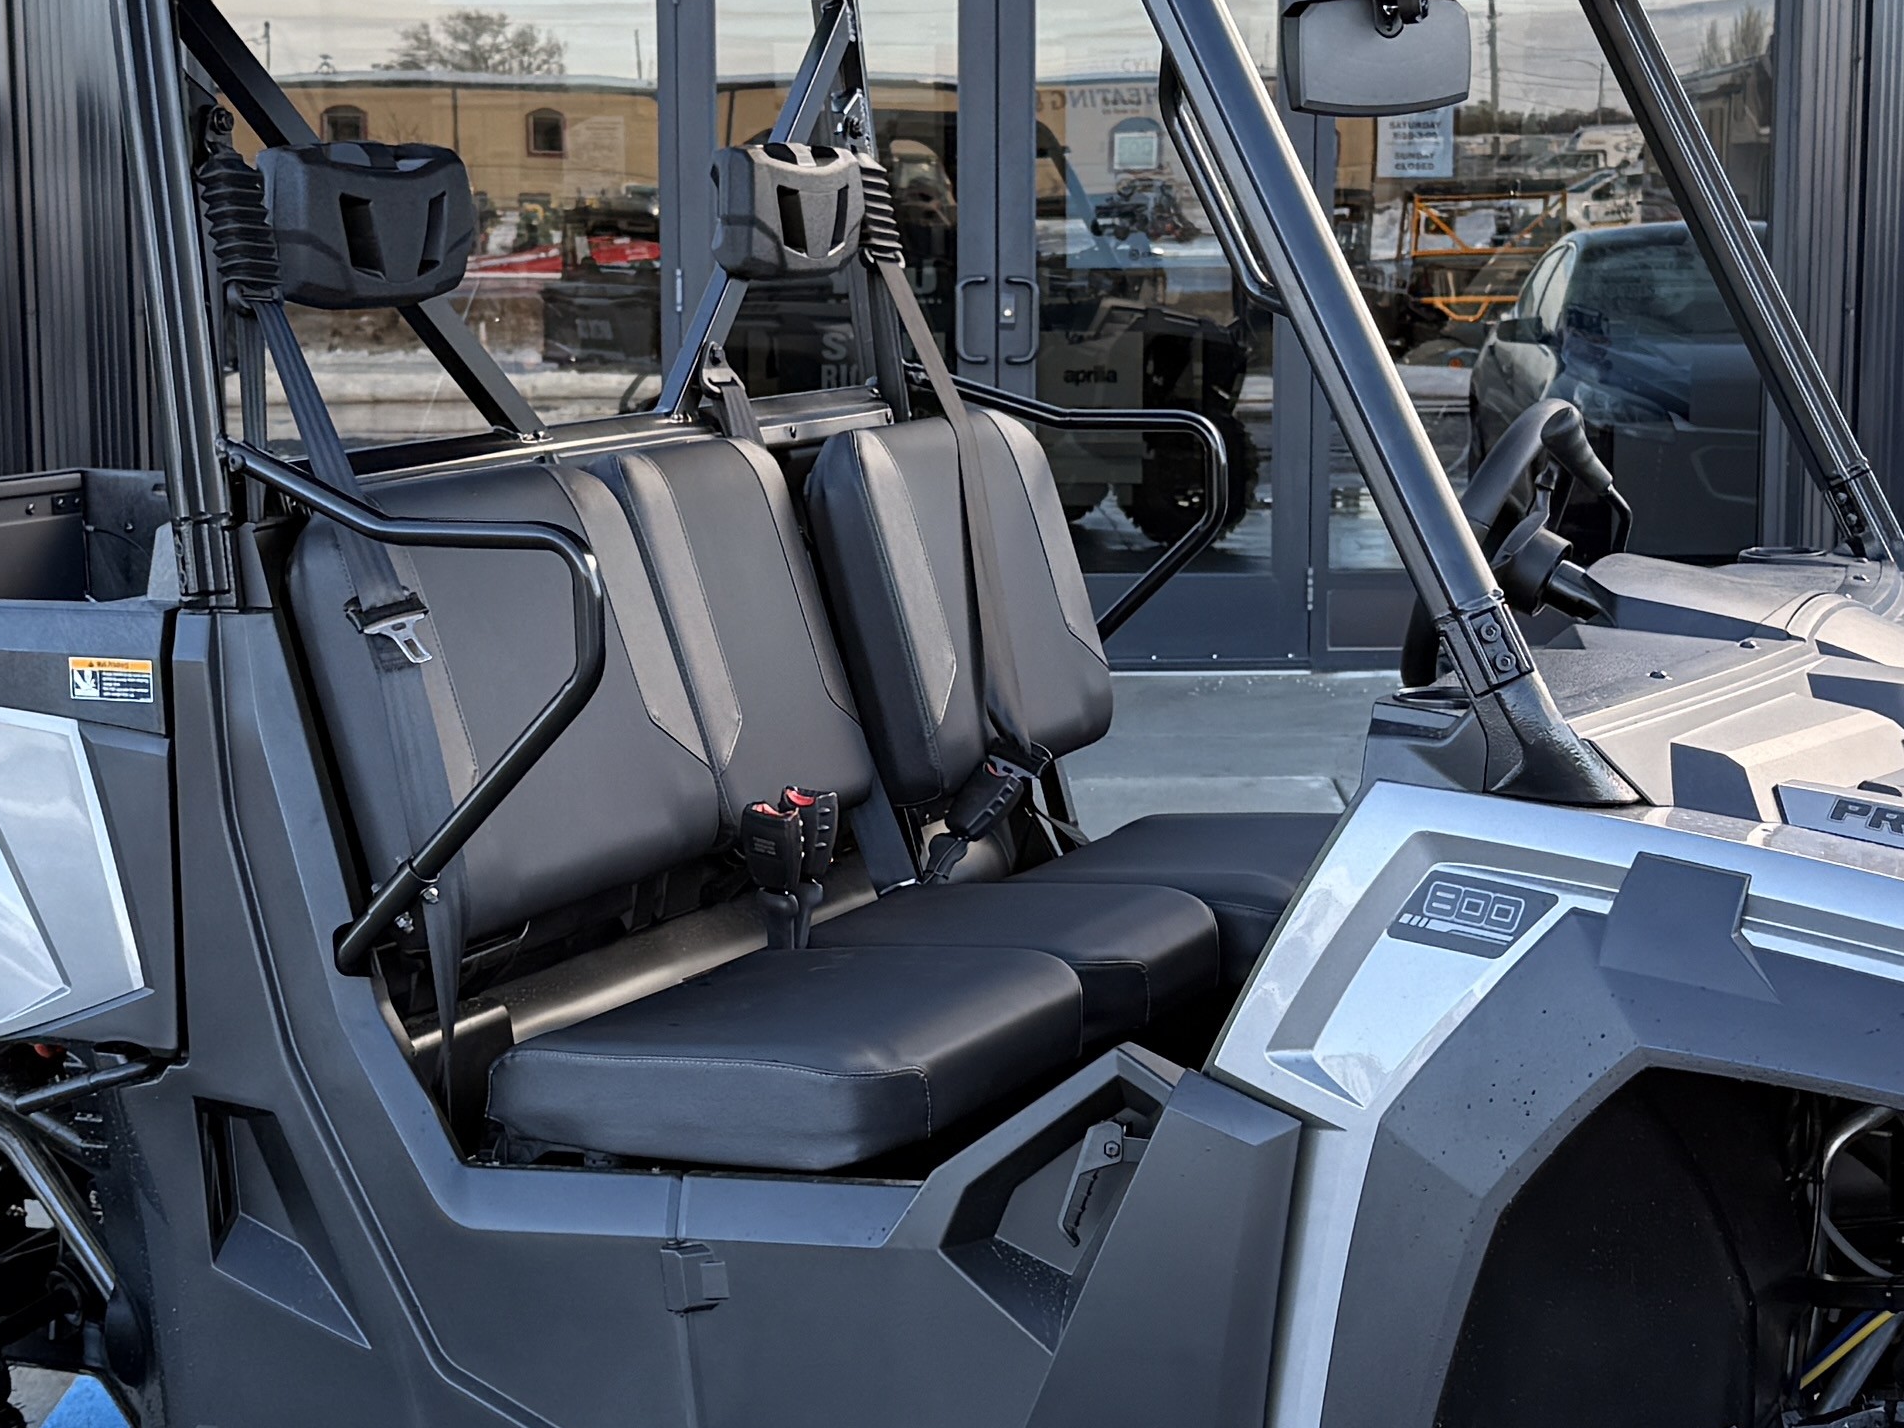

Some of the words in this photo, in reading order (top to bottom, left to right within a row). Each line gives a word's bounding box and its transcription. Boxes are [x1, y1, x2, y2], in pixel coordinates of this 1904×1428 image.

[1389, 120, 1442, 129] SATURDAY
[1394, 162, 1435, 170] CLOSED
[1423, 880, 1525, 934] 800
